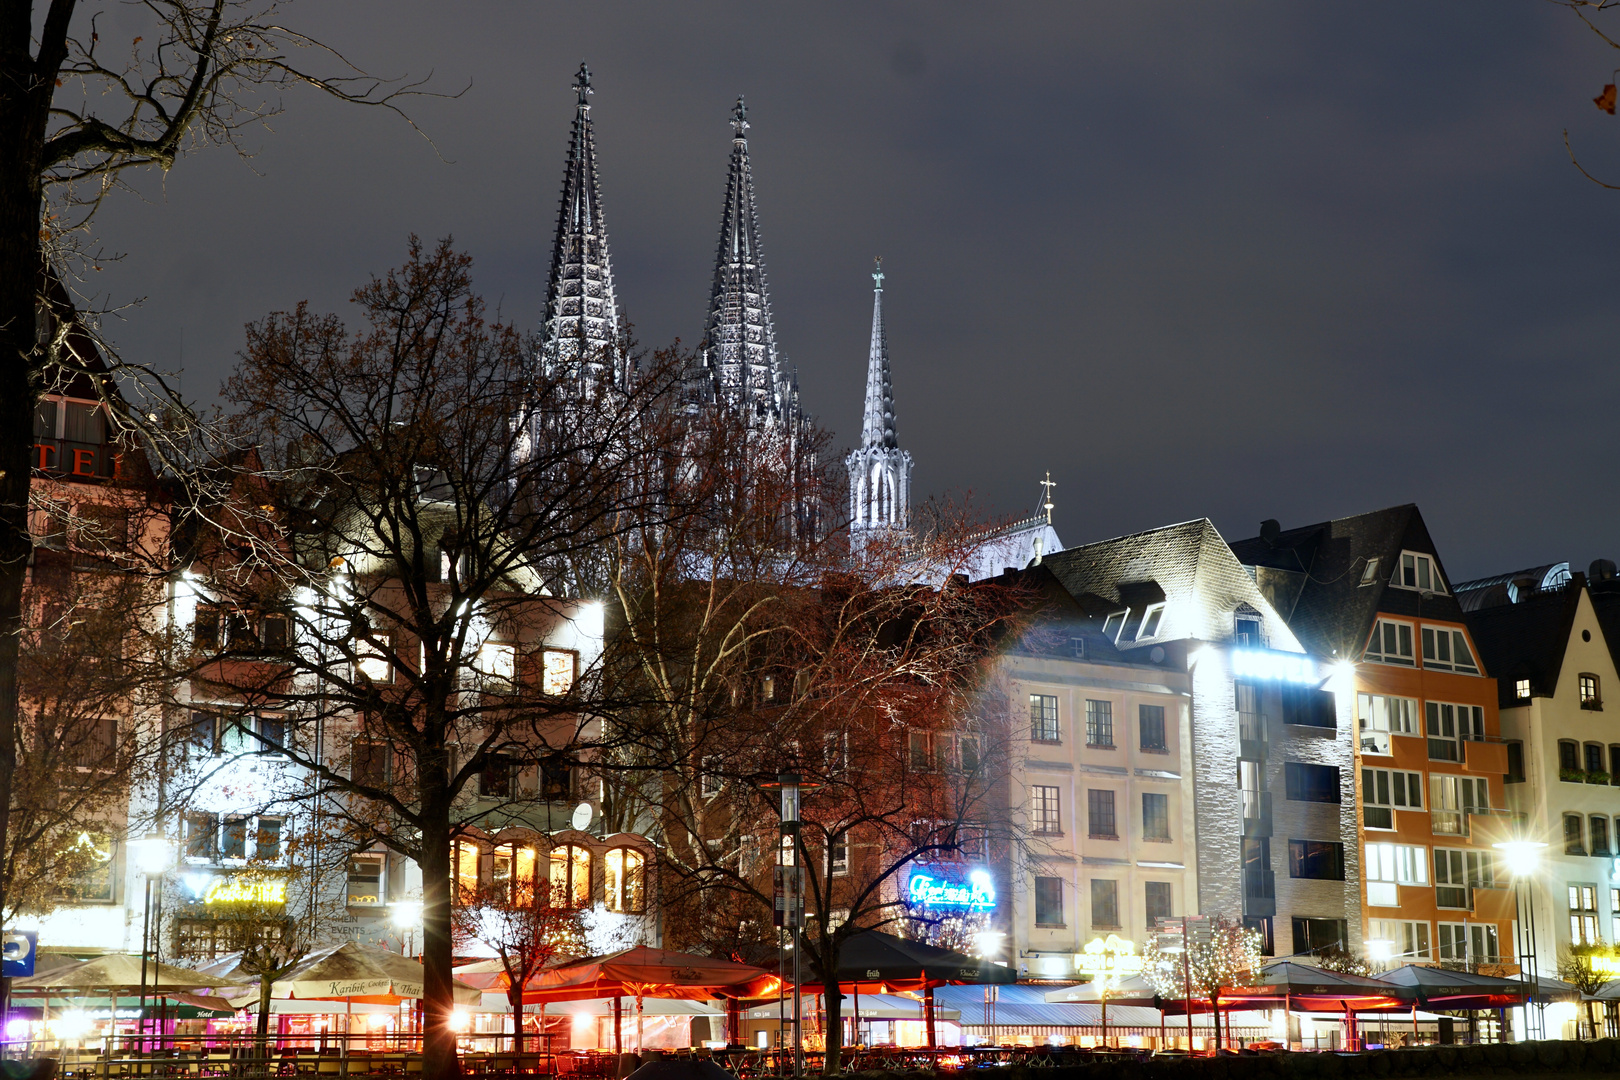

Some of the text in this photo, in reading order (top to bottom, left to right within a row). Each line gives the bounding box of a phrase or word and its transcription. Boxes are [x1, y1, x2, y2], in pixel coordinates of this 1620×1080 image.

[34, 443, 133, 481] TEL
[331, 926, 365, 935] EVENTS
[329, 981, 367, 996] Karibik
[400, 983, 421, 995] Thai
